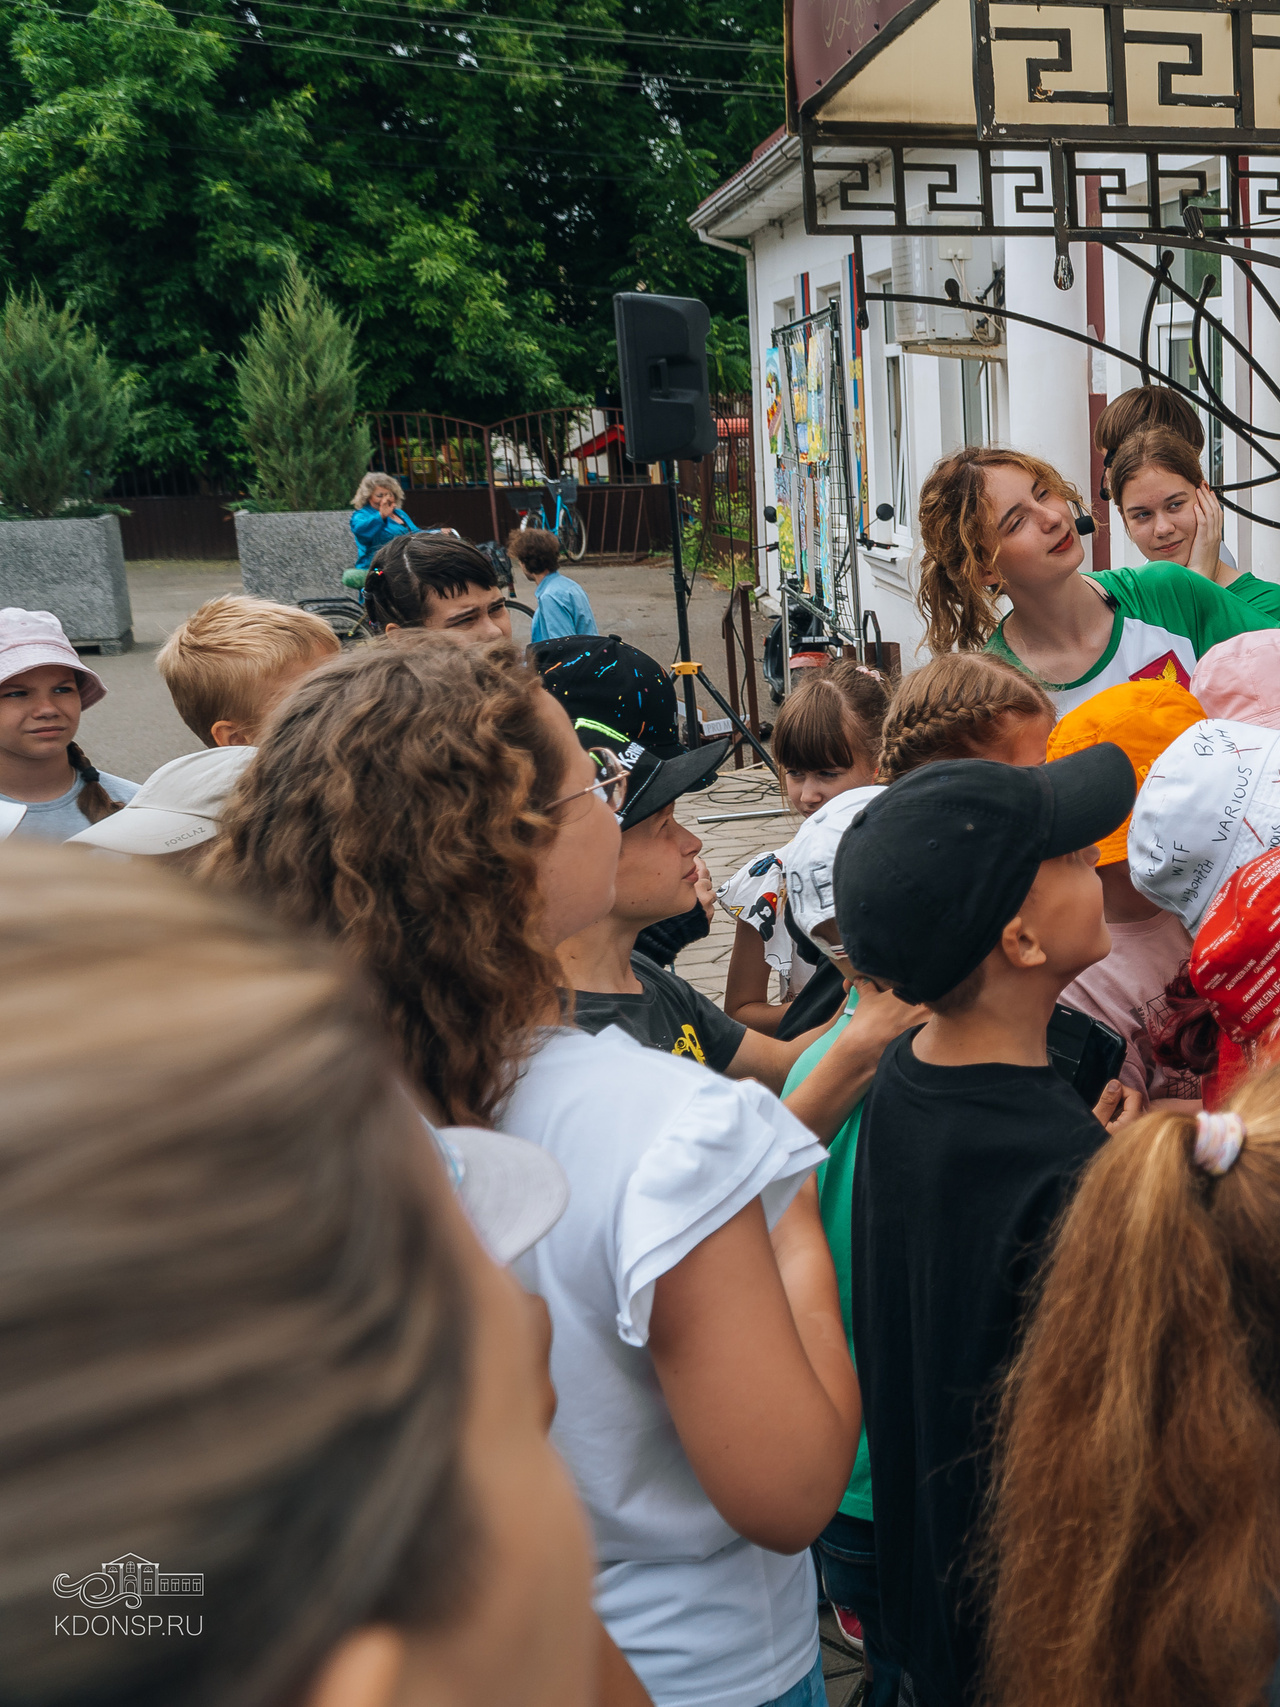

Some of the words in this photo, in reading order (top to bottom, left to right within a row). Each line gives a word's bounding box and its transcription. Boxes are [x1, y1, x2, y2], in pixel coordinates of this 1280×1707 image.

[1211, 765, 1253, 842] VARIOUS
[164, 826, 206, 847] FORCLAZ
[1171, 840, 1190, 876] WTF
[1257, 875, 1272, 890] KLEIN
[1253, 958, 1268, 973] CALVIN
[1265, 947, 1278, 961] KLEIN
[1243, 987, 1256, 1002] CALVIN
[1262, 966, 1276, 981] JEANS
[1241, 1003, 1262, 1024] CALVIN
[1256, 988, 1277, 1009] KLEIN
